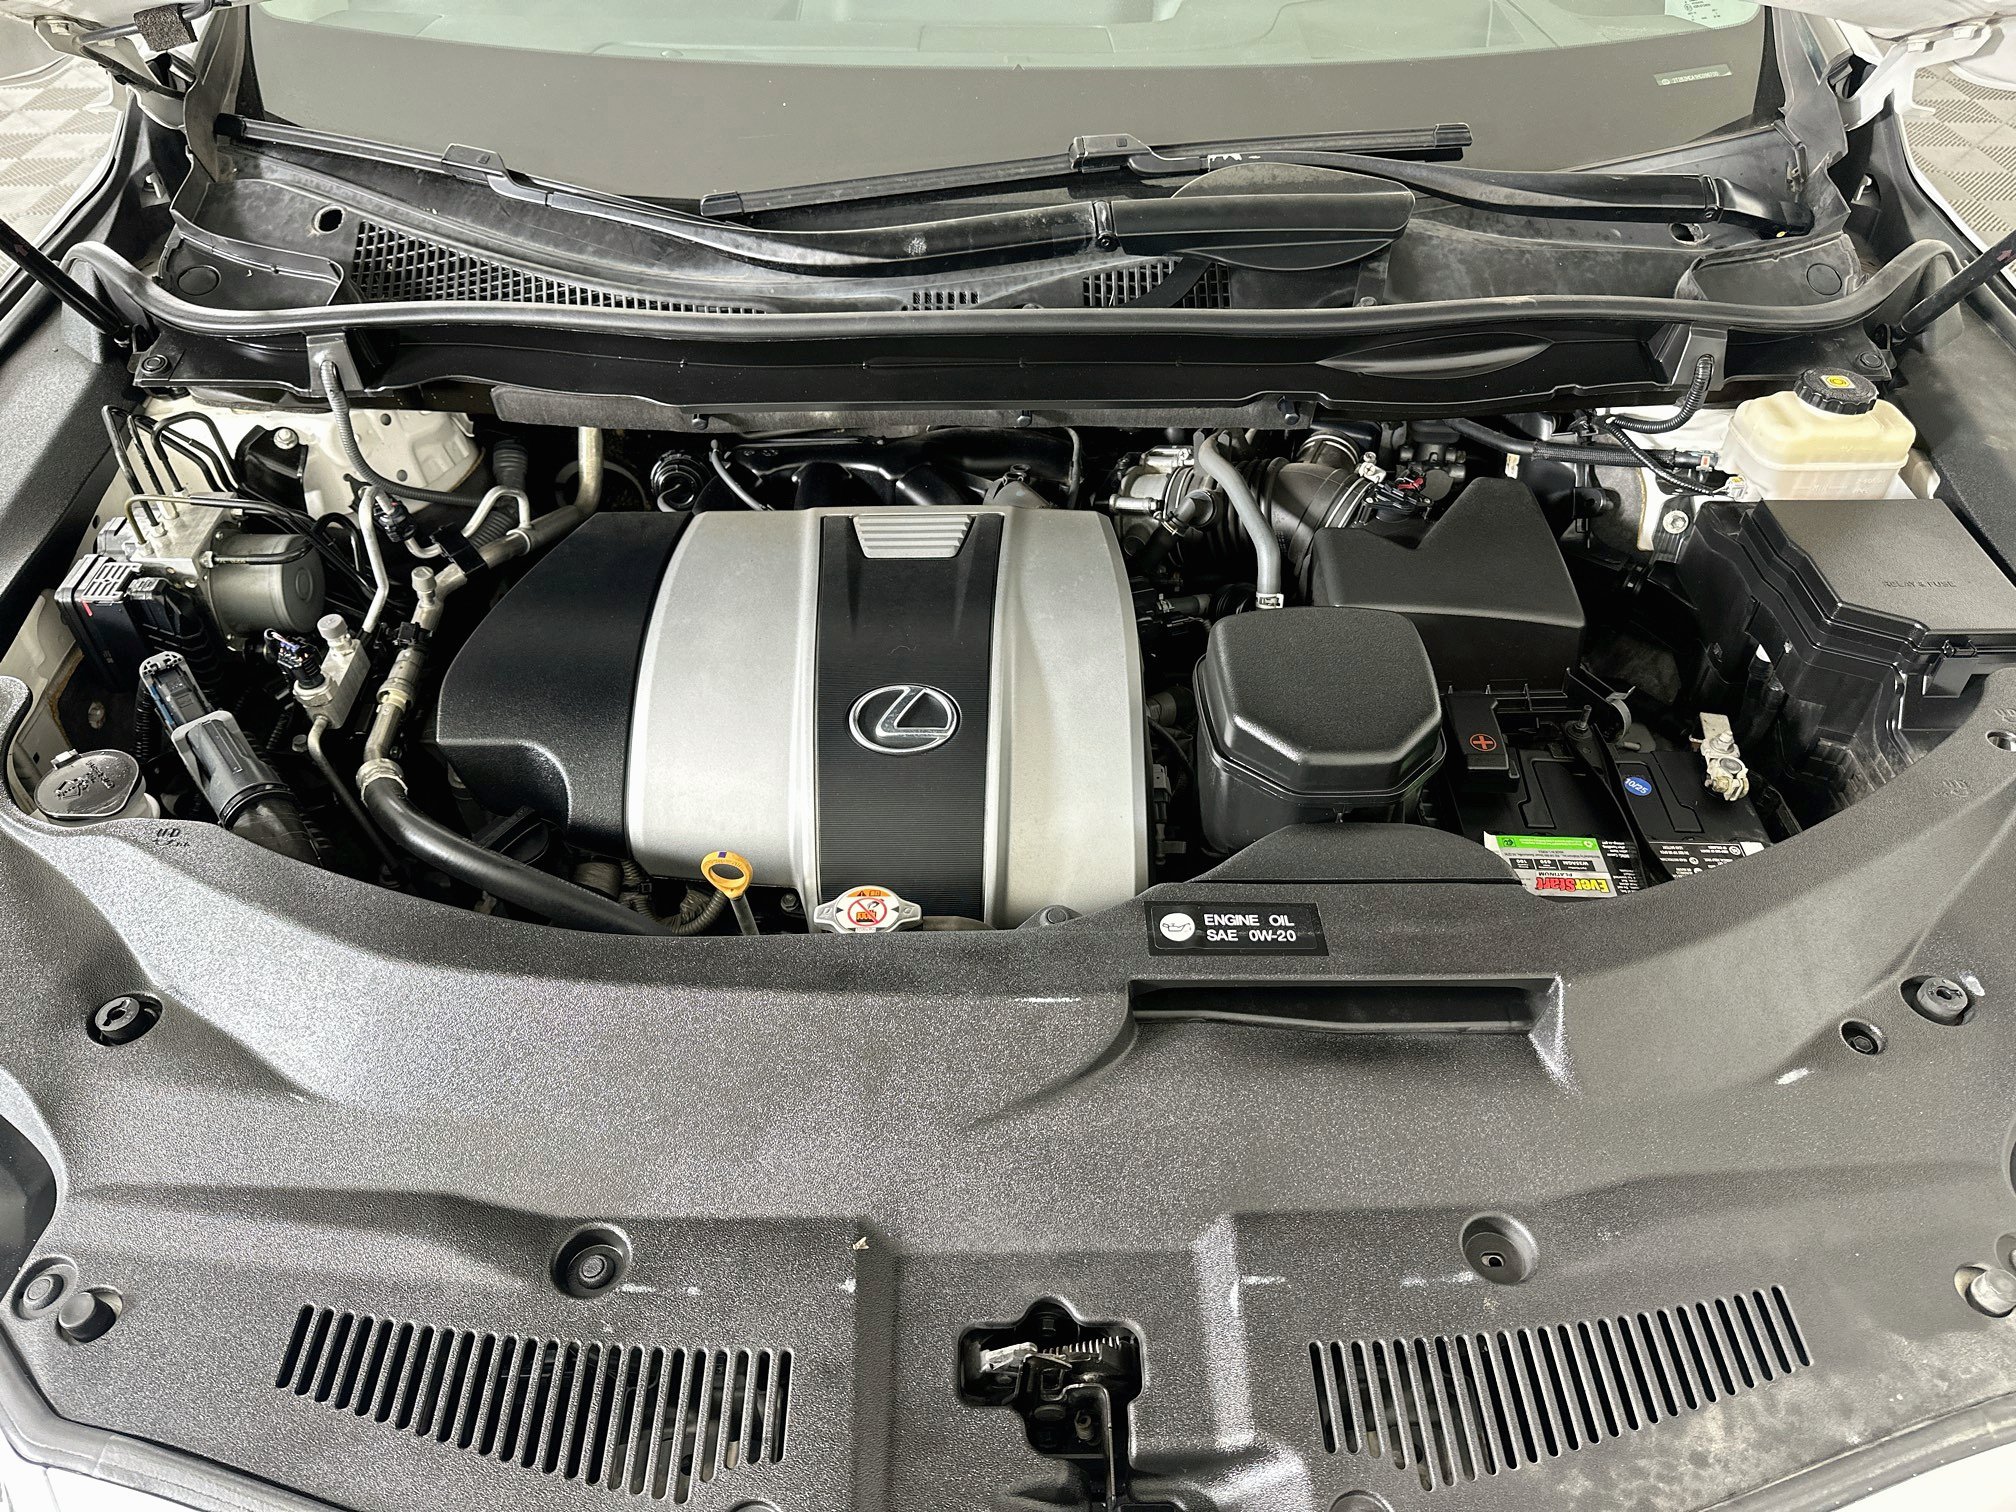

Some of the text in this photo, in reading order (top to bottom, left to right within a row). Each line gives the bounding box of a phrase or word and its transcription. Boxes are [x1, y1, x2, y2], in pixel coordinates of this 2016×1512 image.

[1624, 778, 1649, 794] 10/25
[1535, 877, 1611, 893] EverStart
[1203, 913, 1295, 927] ENGINE OIL
[1206, 929, 1297, 943] SAE 0W-20
